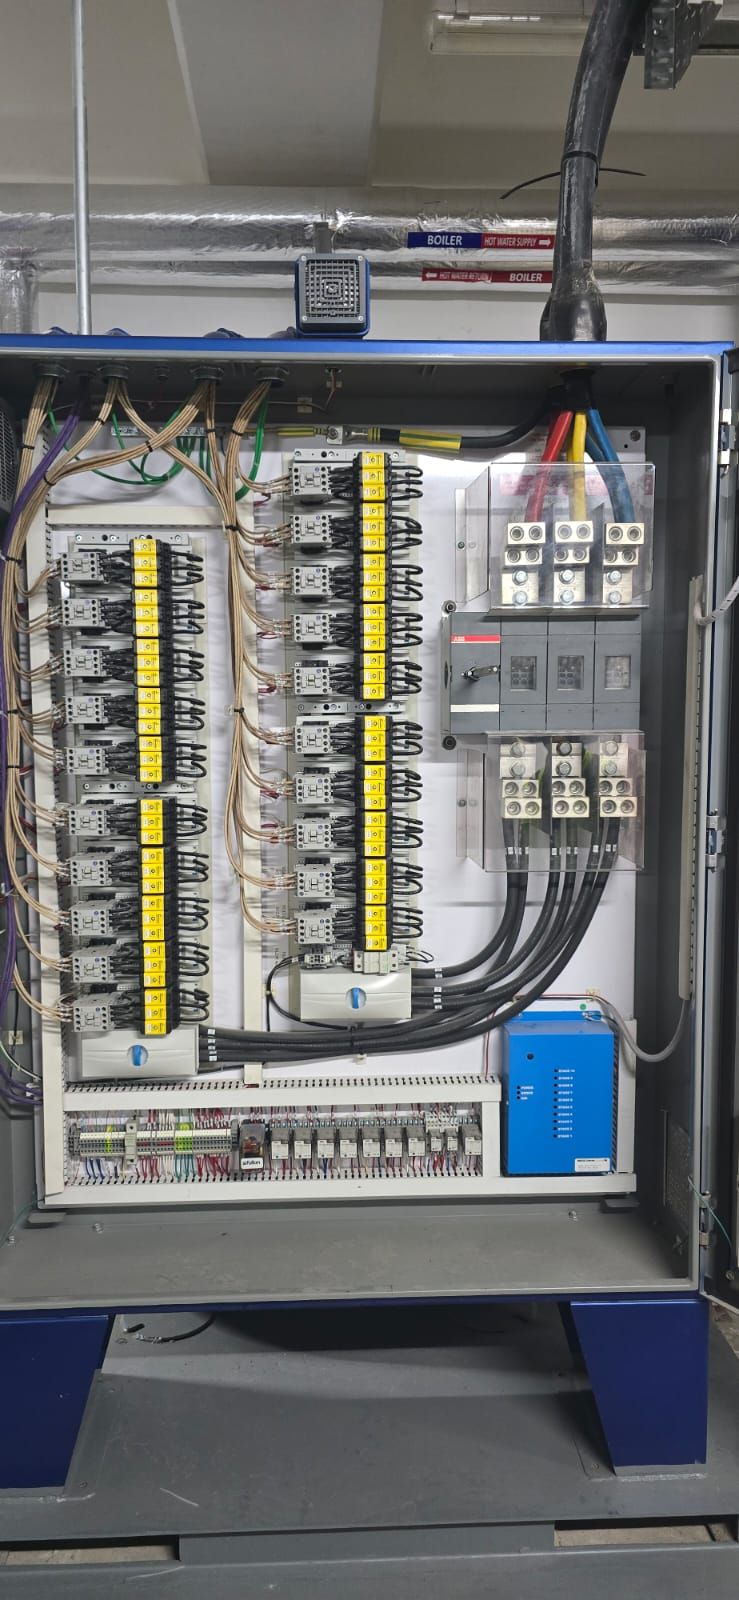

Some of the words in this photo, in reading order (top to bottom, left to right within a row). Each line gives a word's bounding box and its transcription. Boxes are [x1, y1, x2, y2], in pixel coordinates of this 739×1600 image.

[427, 234, 462, 246] BOILER
[484, 237, 496, 245] HOT
[497, 237, 515, 246] WATER
[517, 237, 537, 247] SUPPLY
[509, 273, 543, 282] BOILER
